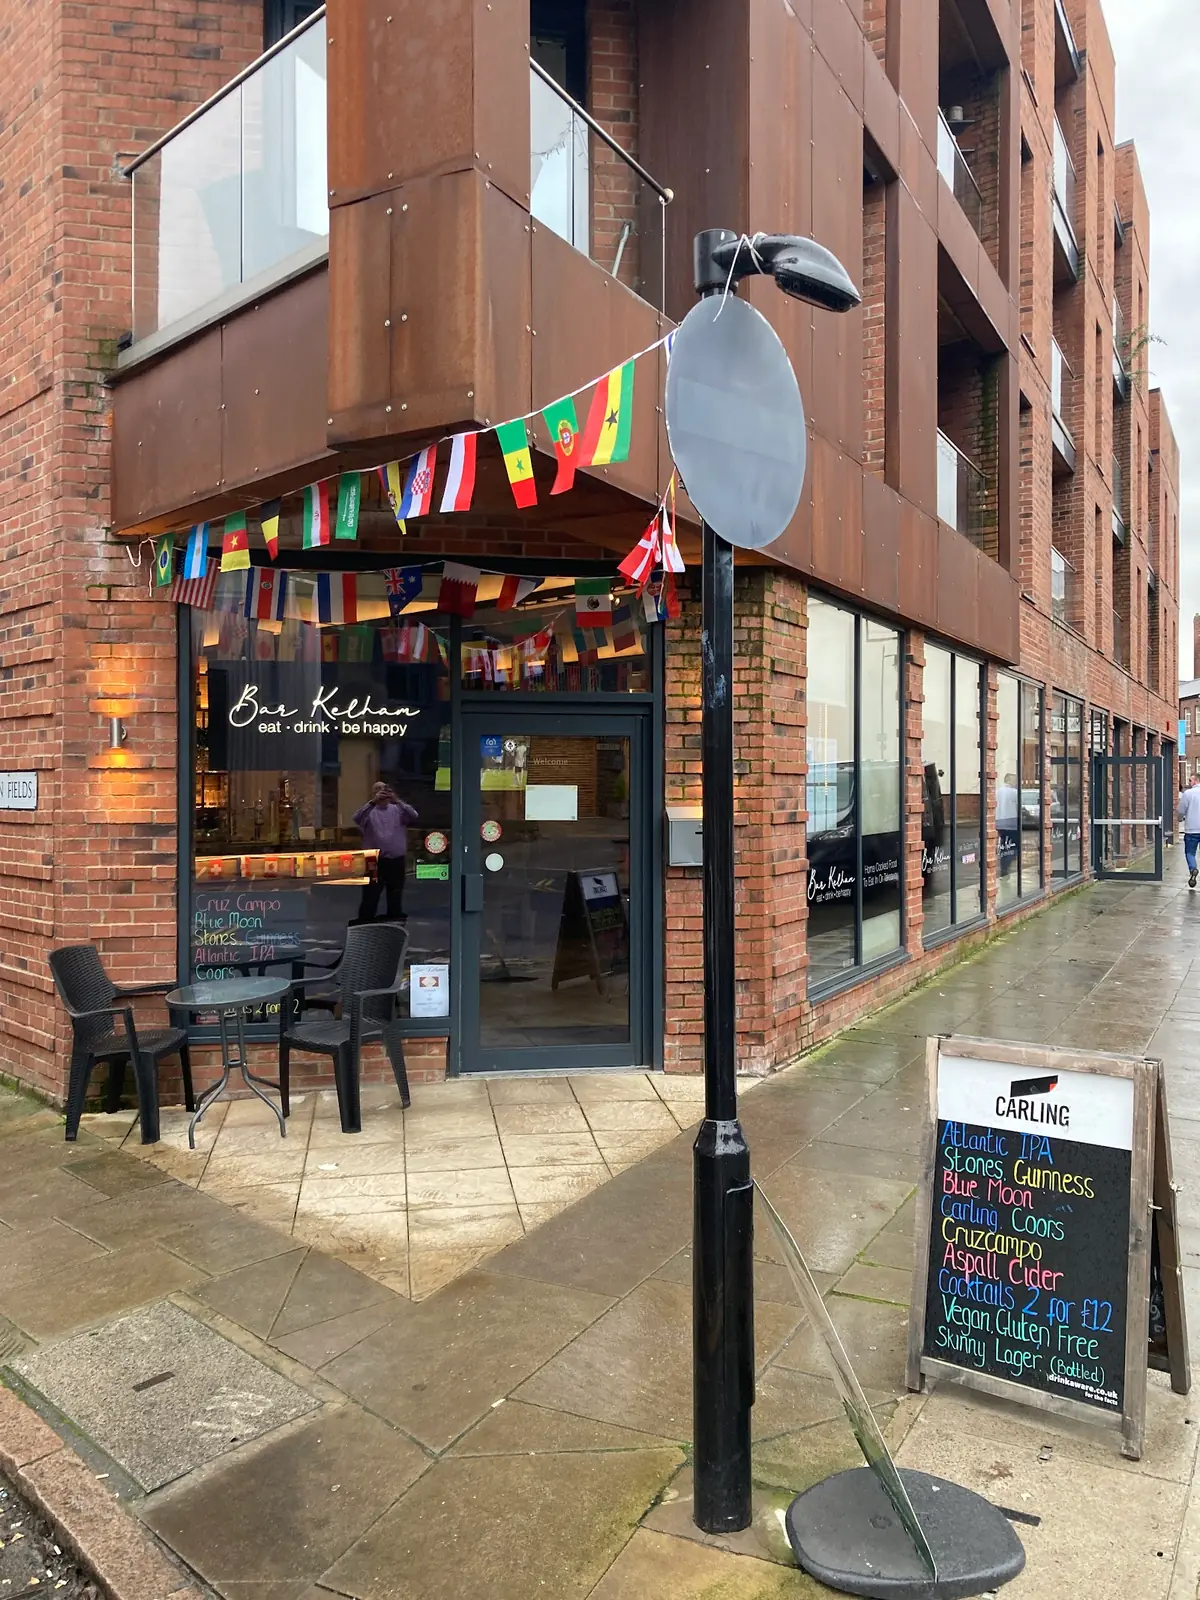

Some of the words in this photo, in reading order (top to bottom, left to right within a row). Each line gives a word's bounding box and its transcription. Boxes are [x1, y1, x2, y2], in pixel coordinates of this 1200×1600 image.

[229, 684, 298, 727] Bar
[311, 686, 420, 720] Kelham
[258, 722, 281, 733] eat
[294, 721, 330, 733] drink
[342, 721, 360, 733] be
[363, 721, 407, 736] happy
[533, 757, 568, 766] Welcome
[8, 781, 32, 798] FIELDS
[864, 864, 875, 874] Home
[876, 861, 888, 872] Cooked
[889, 859, 898, 869] Food
[808, 868, 826, 900] Bar
[195, 912, 224, 929] Blue
[229, 912, 262, 928] Moon
[196, 894, 230, 912] Cruz
[237, 894, 281, 918] Campo
[195, 948, 240, 963] Atlantic
[249, 945, 275, 961] IPA
[196, 964, 235, 980] Coors
[996, 1096, 1070, 1127] CARLING
[941, 1120, 1008, 1156] Atlantic
[1018, 1132, 1054, 1165] IPA
[943, 1170, 978, 1198] Blue
[987, 1179, 1034, 1209] Moon
[1014, 1159, 1095, 1199] Guinness
[1012, 1208, 1064, 1241] Coors
[942, 1218, 1042, 1267] Cruzcampo
[943, 1242, 999, 1284] Aspall
[1009, 1259, 1064, 1291] Cider
[938, 1268, 1015, 1310] Cocktails
[1022, 1287, 1040, 1316] 2
[1046, 1298, 1075, 1326] for
[1080, 1298, 1113, 1332] £12
[995, 1309, 1050, 1347] Gluten
[1058, 1325, 1100, 1359] Free
[935, 1326, 986, 1368] Skinny
[1050, 1355, 1105, 1387] (Bottled)
[1049, 1374, 1118, 1399] drinkaware.co.uk
[1085, 1391, 1094, 1399] for
[1094, 1394, 1104, 1402] the
[1104, 1397, 1118, 1406] facts
